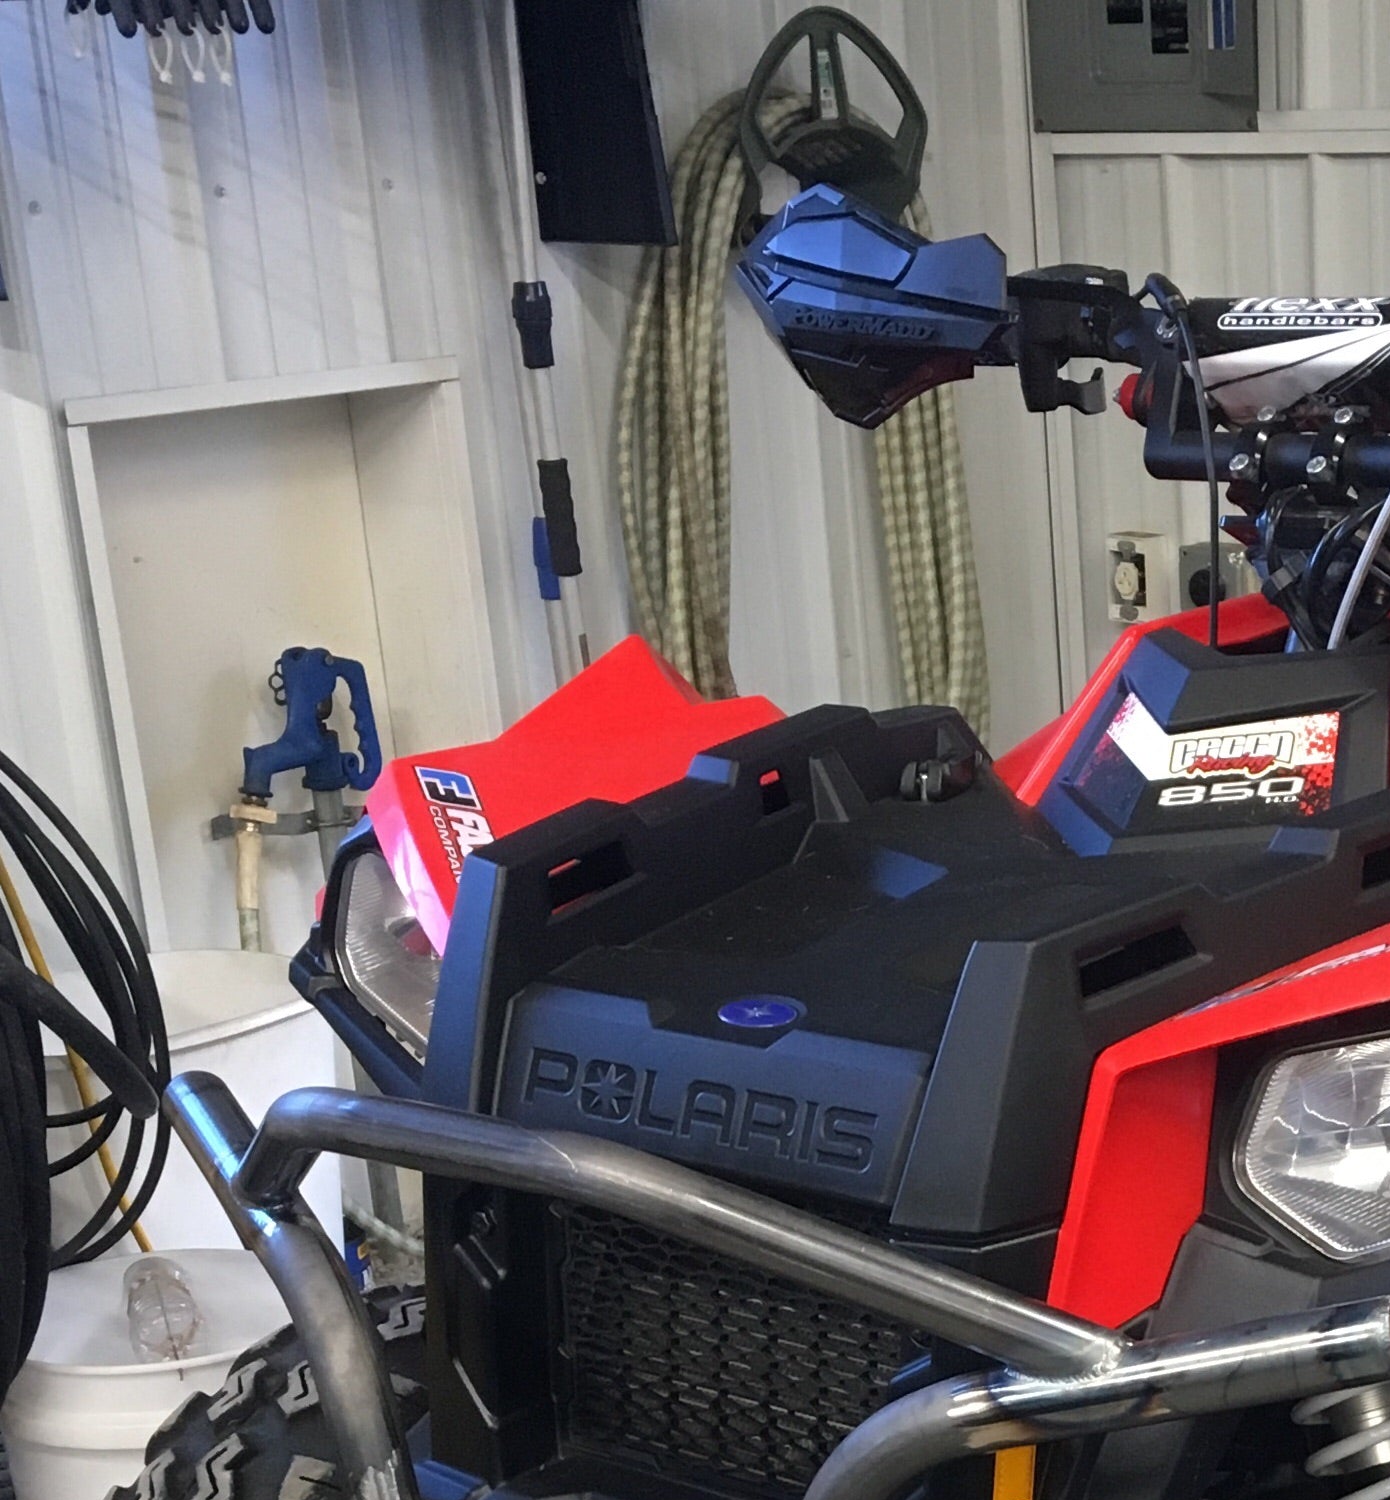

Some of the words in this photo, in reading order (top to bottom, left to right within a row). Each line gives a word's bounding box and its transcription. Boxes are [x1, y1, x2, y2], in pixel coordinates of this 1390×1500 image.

[1222, 315, 1376, 327] handlebars
[1158, 777, 1305, 806] 850
[429, 805, 462, 884] COMPAN
[445, 808, 495, 858] FA
[522, 1047, 880, 1175] POLARIS
